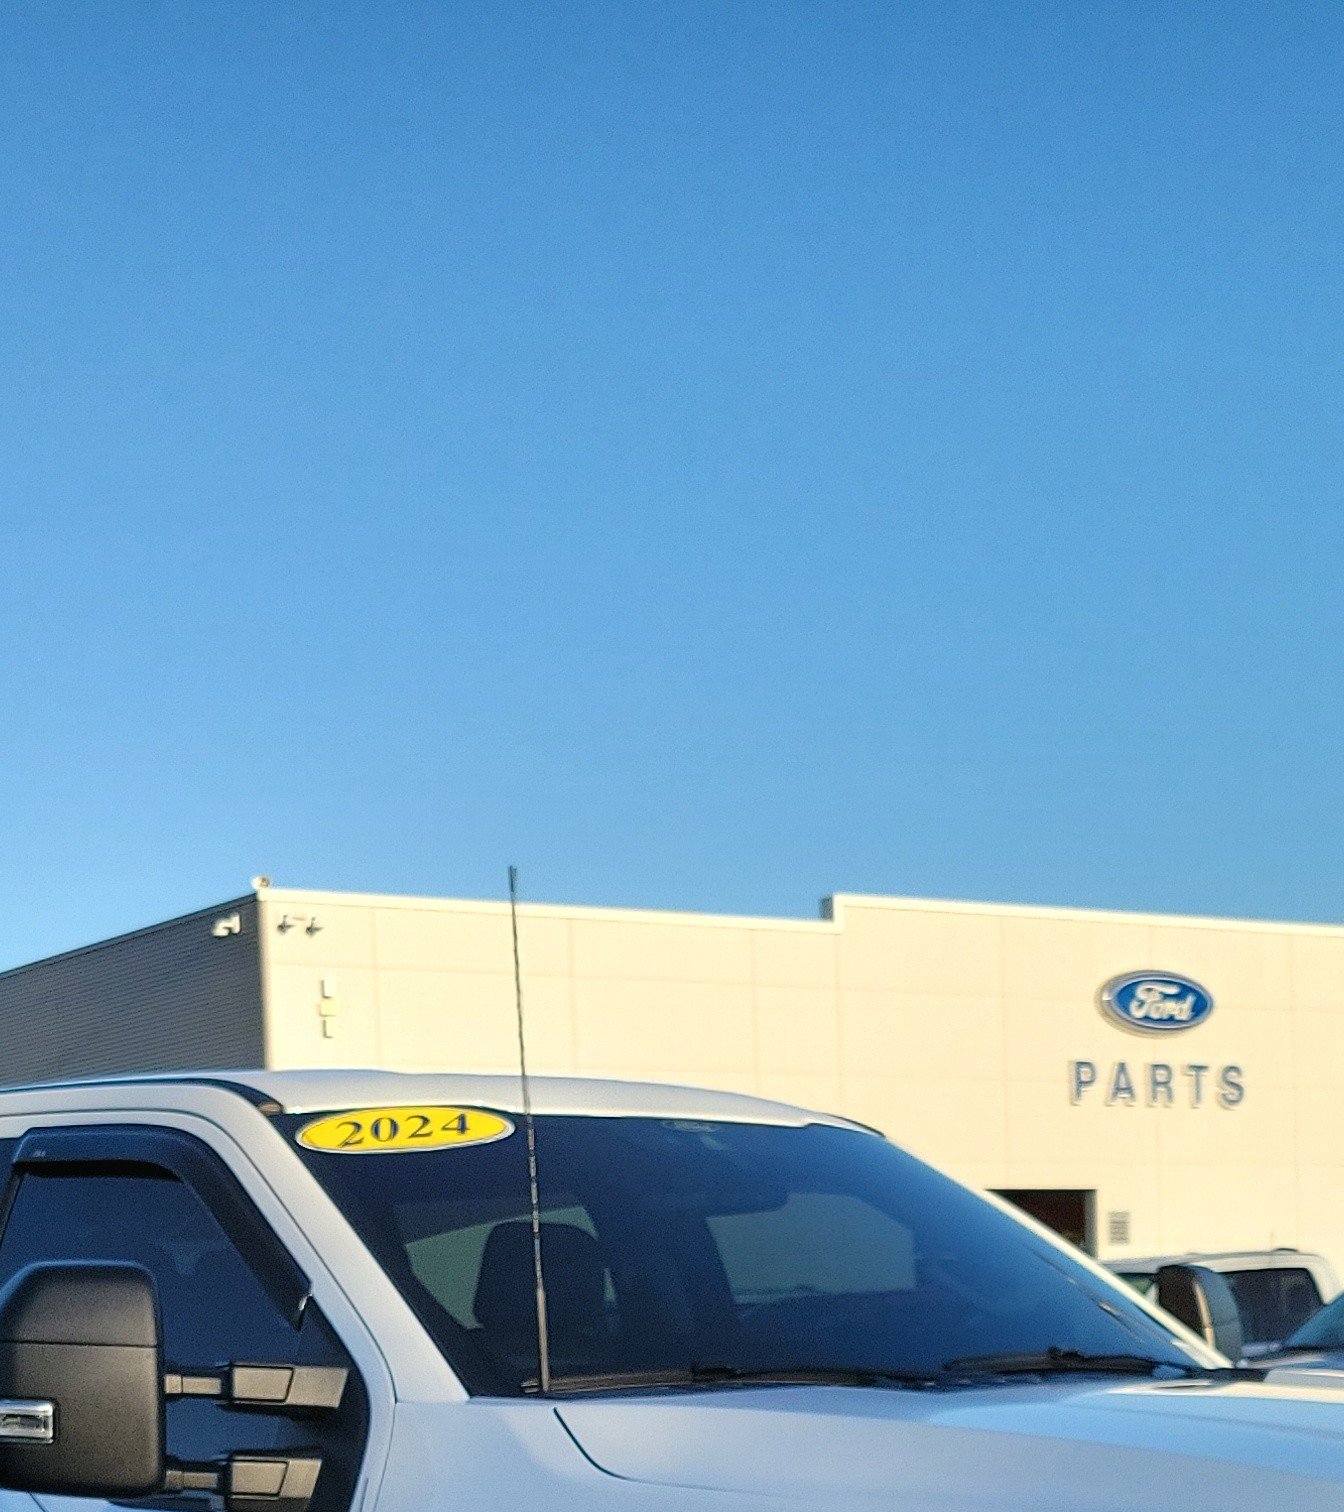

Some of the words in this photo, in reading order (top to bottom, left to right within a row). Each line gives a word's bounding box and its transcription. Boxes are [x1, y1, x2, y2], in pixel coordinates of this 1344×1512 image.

[1127, 981, 1197, 1023] Ford
[1071, 1059, 1246, 1108] PARTS
[335, 1112, 471, 1148] 2024
